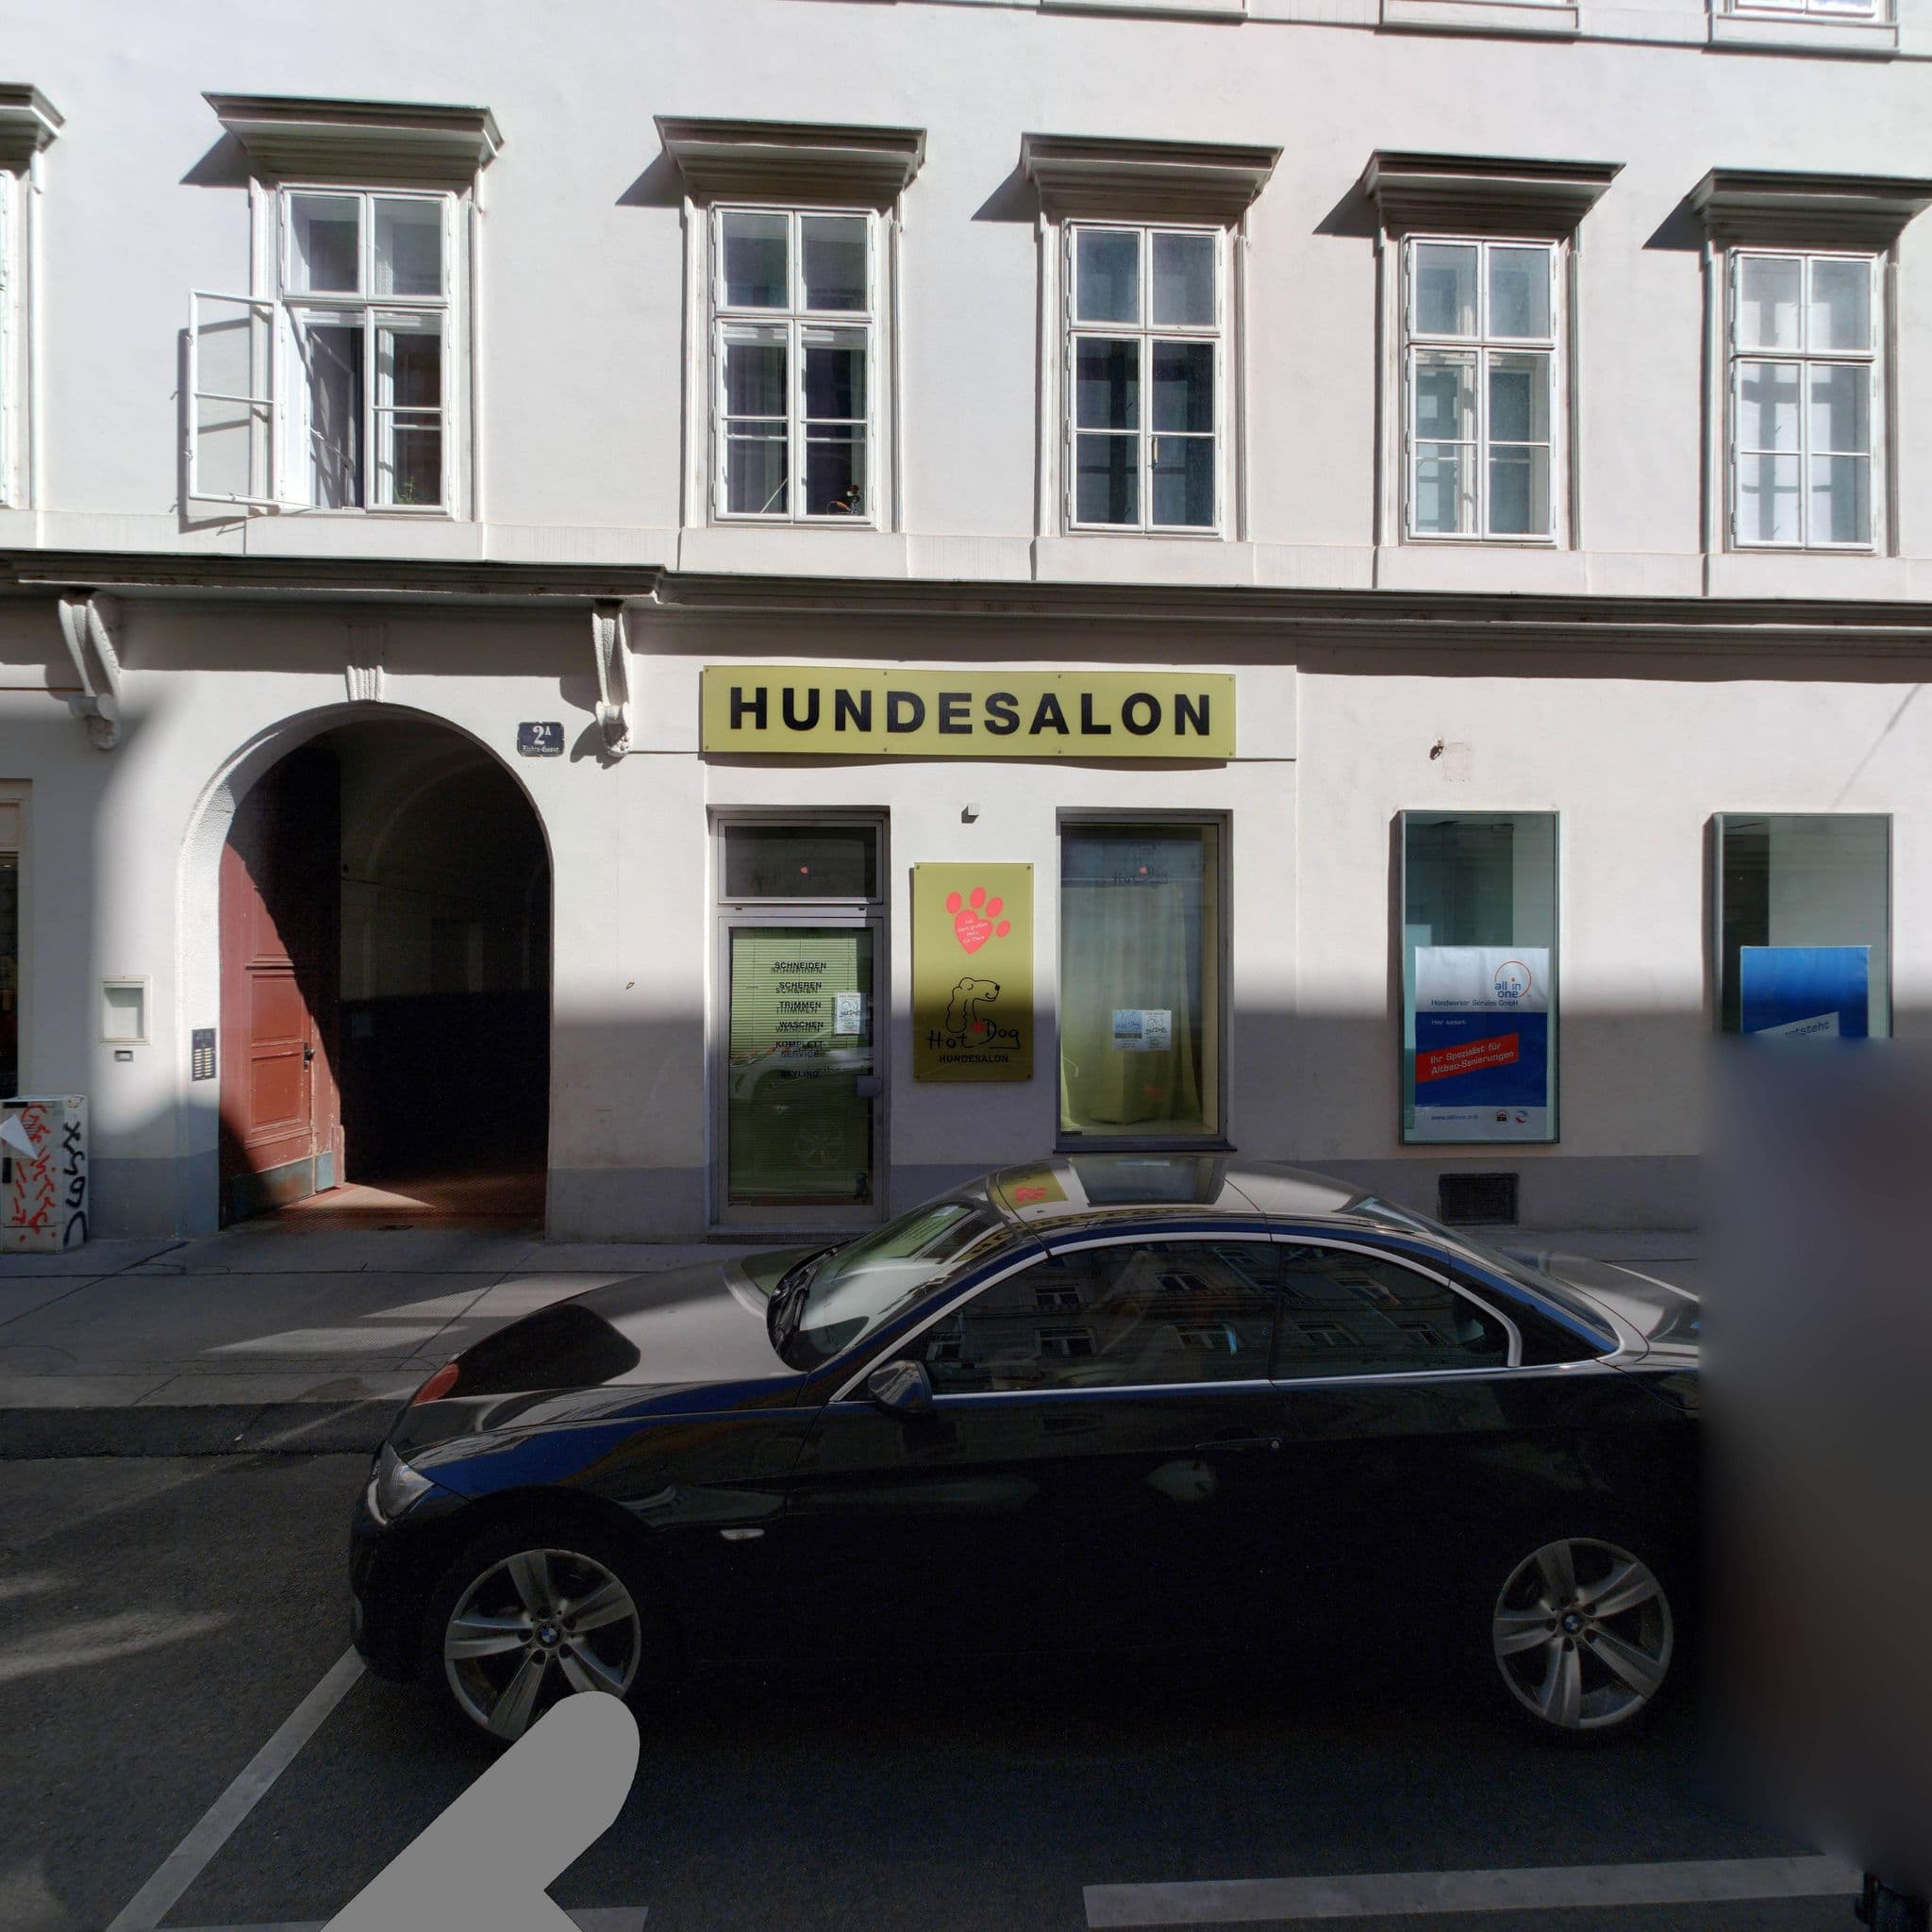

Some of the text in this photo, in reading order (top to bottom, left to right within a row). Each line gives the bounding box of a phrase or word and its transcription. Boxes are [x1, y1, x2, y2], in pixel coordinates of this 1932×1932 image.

[730, 687, 1210, 736] HUNDESALON
[1494, 977, 1521, 991] all in
[926, 1018, 1021, 1050] Hot Dog
[939, 1055, 1008, 1063] HUNDESALON
[1430, 1041, 1502, 1065] Ihr Spezialist für
[1431, 1050, 1514, 1074] Altbau-Sanierungen
